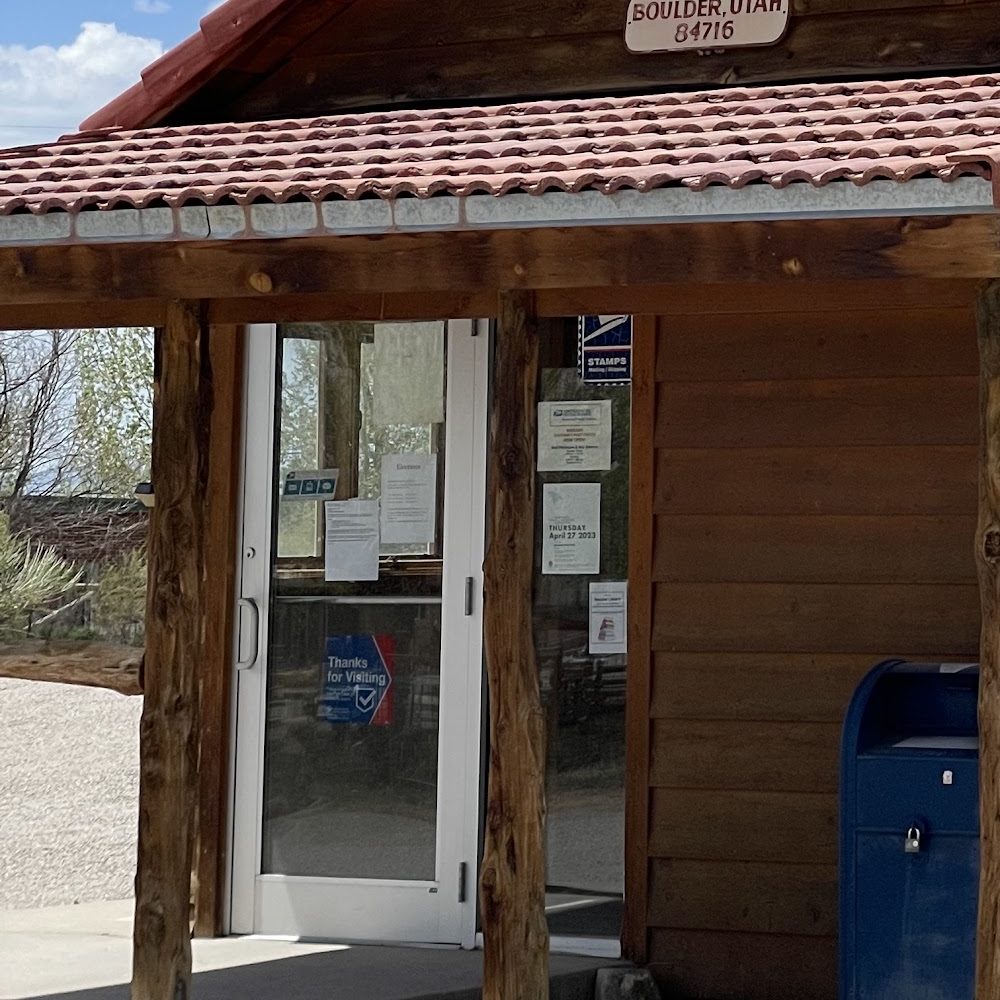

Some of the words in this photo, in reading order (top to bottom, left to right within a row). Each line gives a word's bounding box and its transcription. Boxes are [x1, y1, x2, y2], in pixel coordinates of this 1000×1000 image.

[674, 20, 734, 43] 84716
[587, 356, 627, 366] STAMPS
[549, 531, 566, 540] April
[567, 531, 576, 539] 27
[578, 531, 596, 539] 2023
[327, 656, 368, 669] Thanks
[327, 670, 343, 683] for
[345, 670, 386, 686] Visiting
